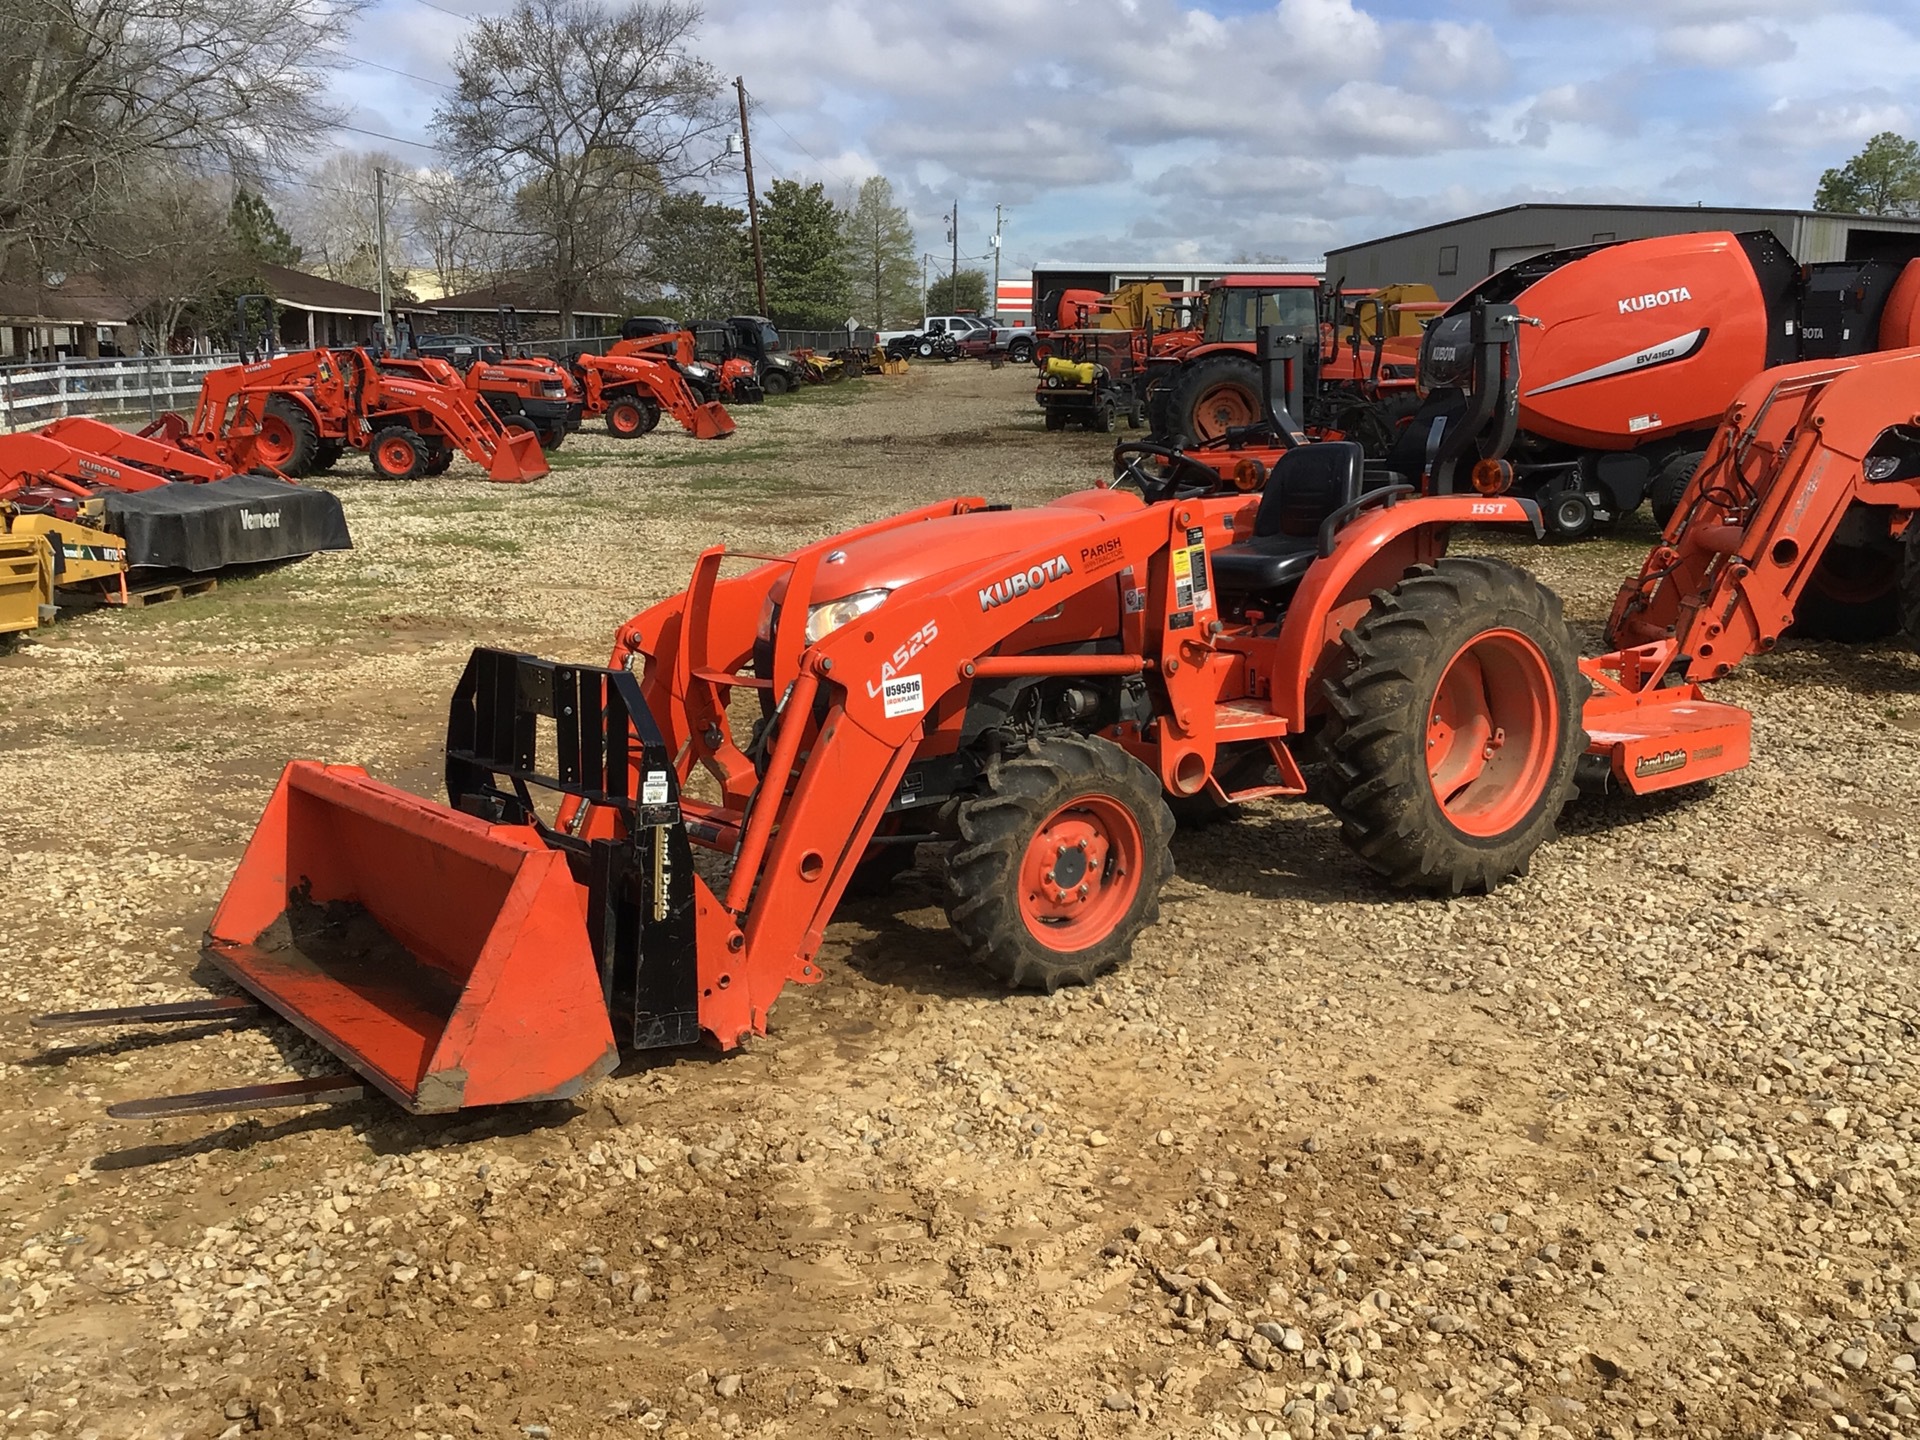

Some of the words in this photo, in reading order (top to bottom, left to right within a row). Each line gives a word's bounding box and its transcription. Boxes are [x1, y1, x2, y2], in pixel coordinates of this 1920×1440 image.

[1618, 287, 1692, 314] KUBOTA
[1636, 348, 1675, 365] BV4160
[390, 386, 417, 396] KUBOTA
[78, 459, 121, 480] KUBOTA
[1471, 503, 1507, 516] HST
[1080, 536, 1122, 563] PARISH
[978, 553, 1074, 613] KUBOTA
[866, 619, 939, 698] LA525
[885, 680, 921, 697] U595916
